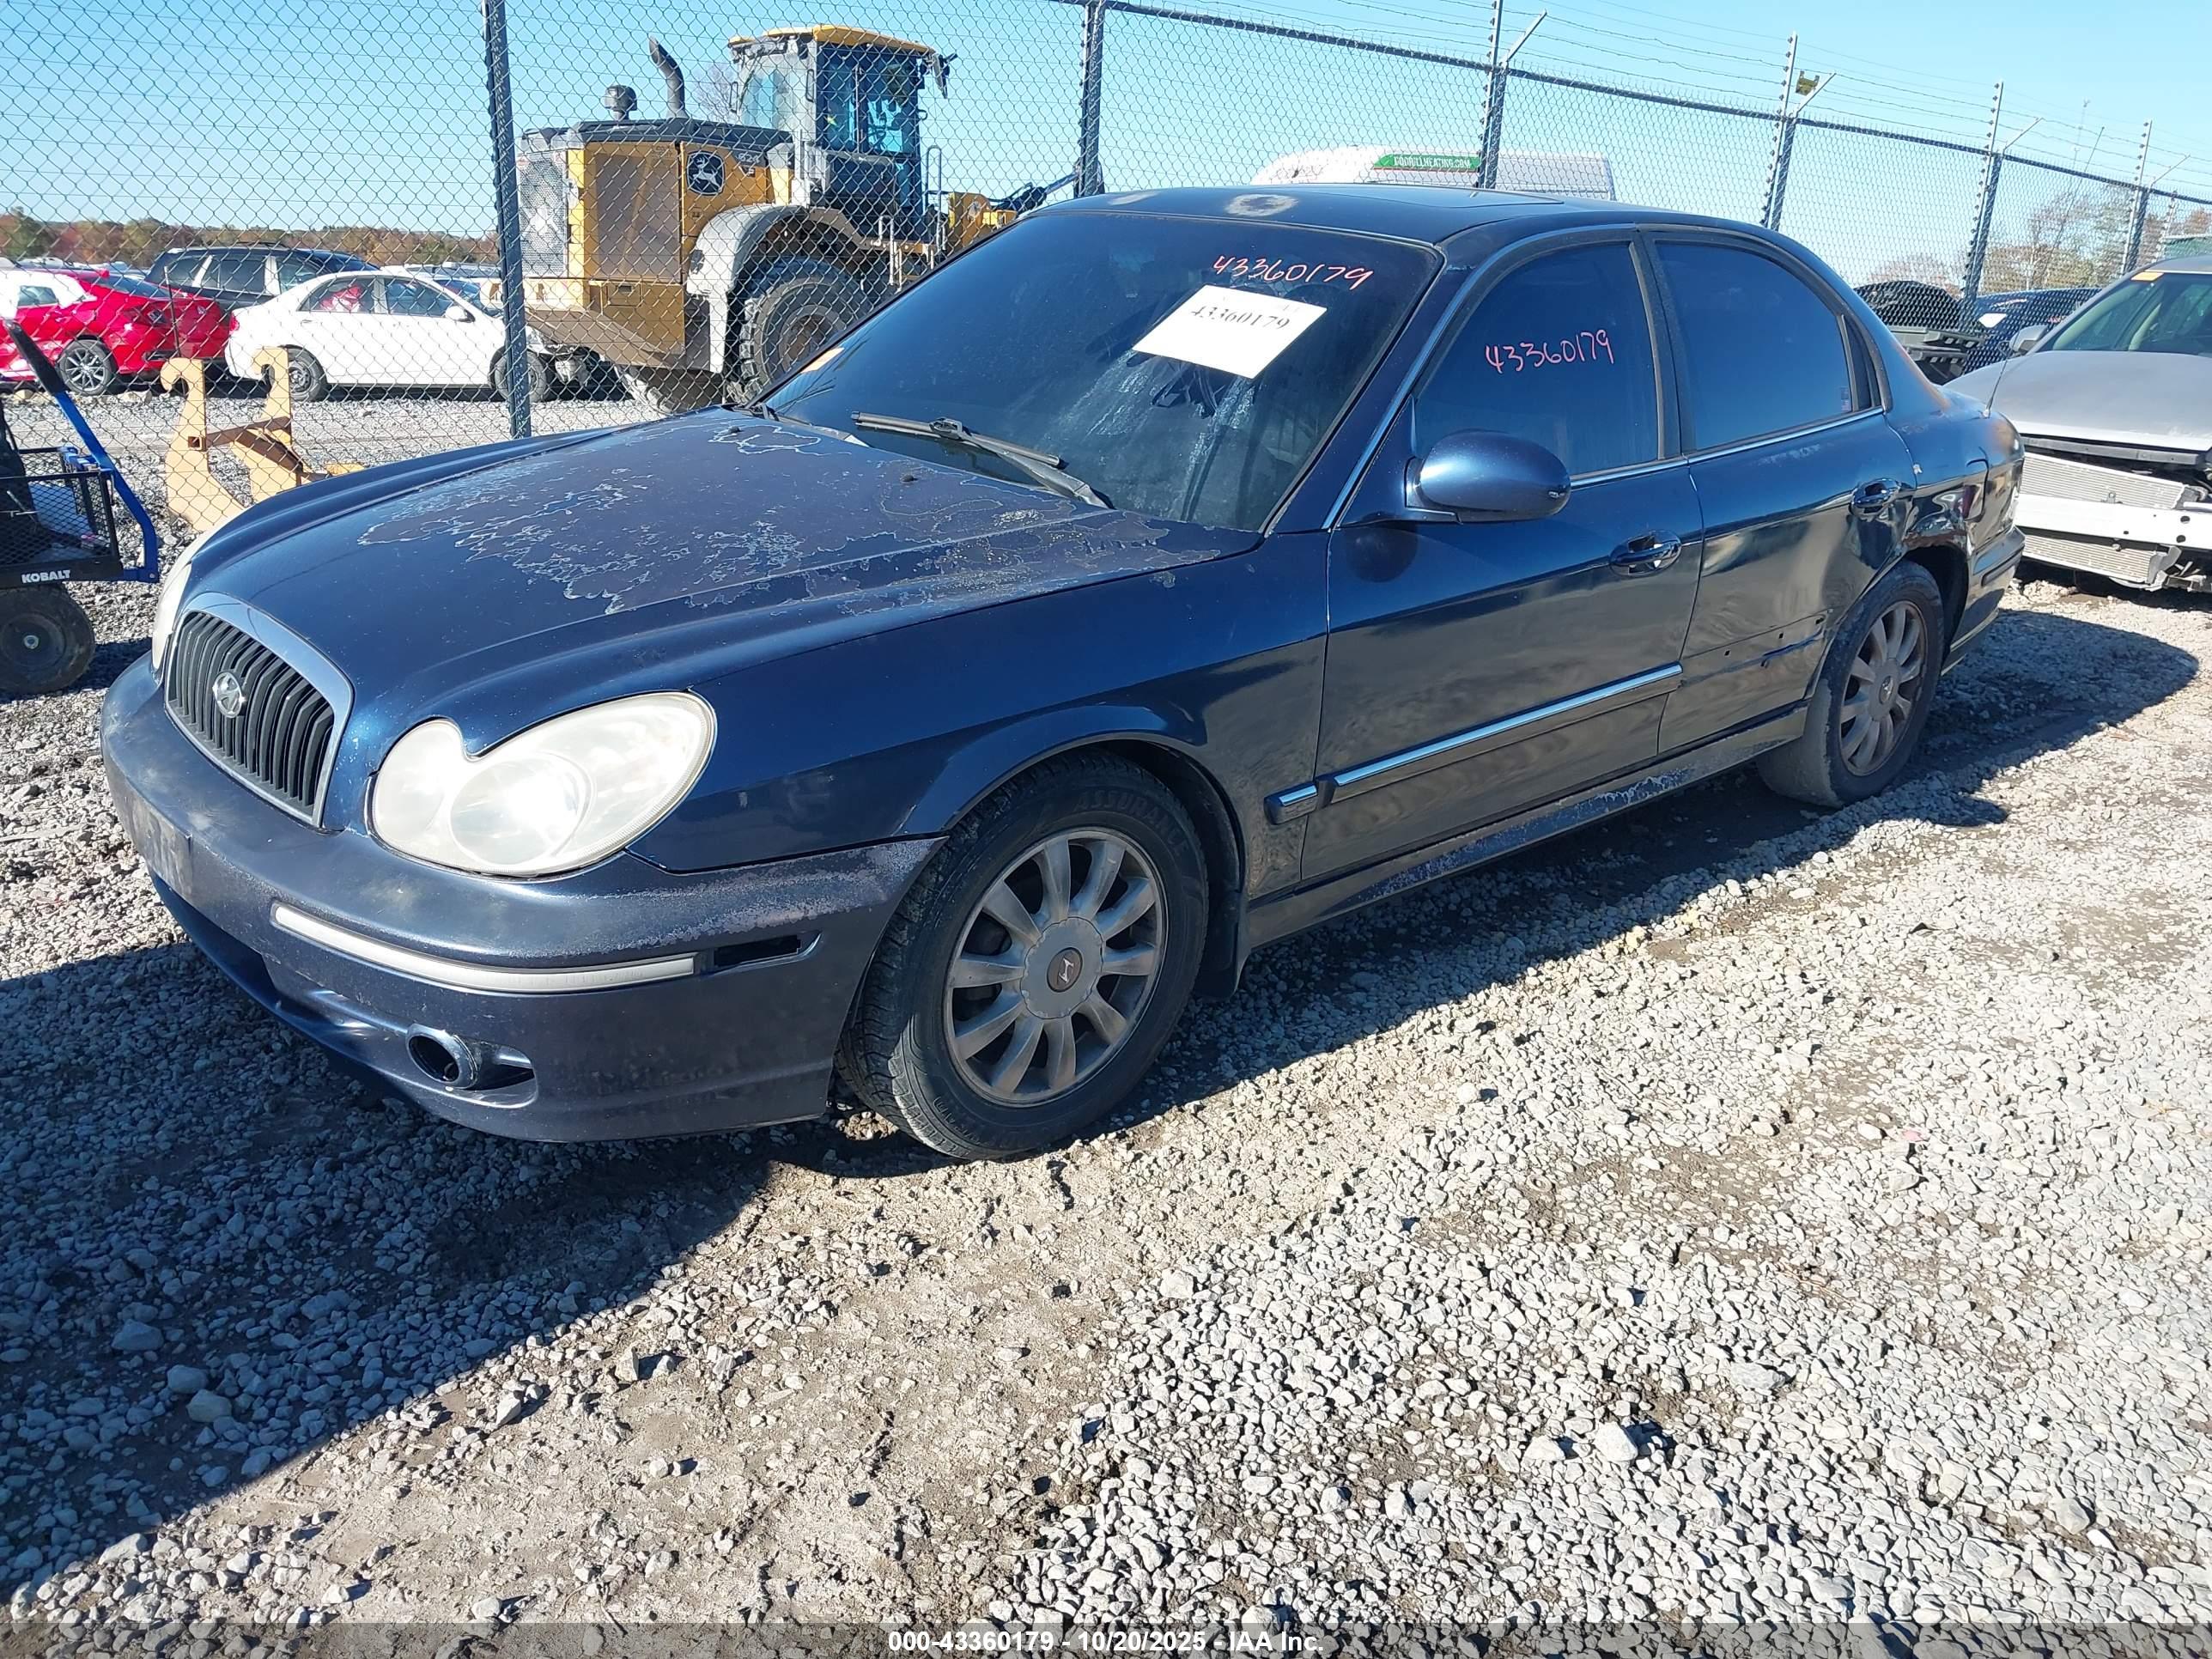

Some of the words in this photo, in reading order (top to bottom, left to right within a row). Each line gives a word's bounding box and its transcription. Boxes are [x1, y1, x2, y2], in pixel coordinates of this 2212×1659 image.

[1213, 255, 1375, 290] 43360179
[1190, 306, 1291, 330] 43360179
[1485, 329, 1614, 374] 43360179
[21, 569, 71, 584] KOBALT
